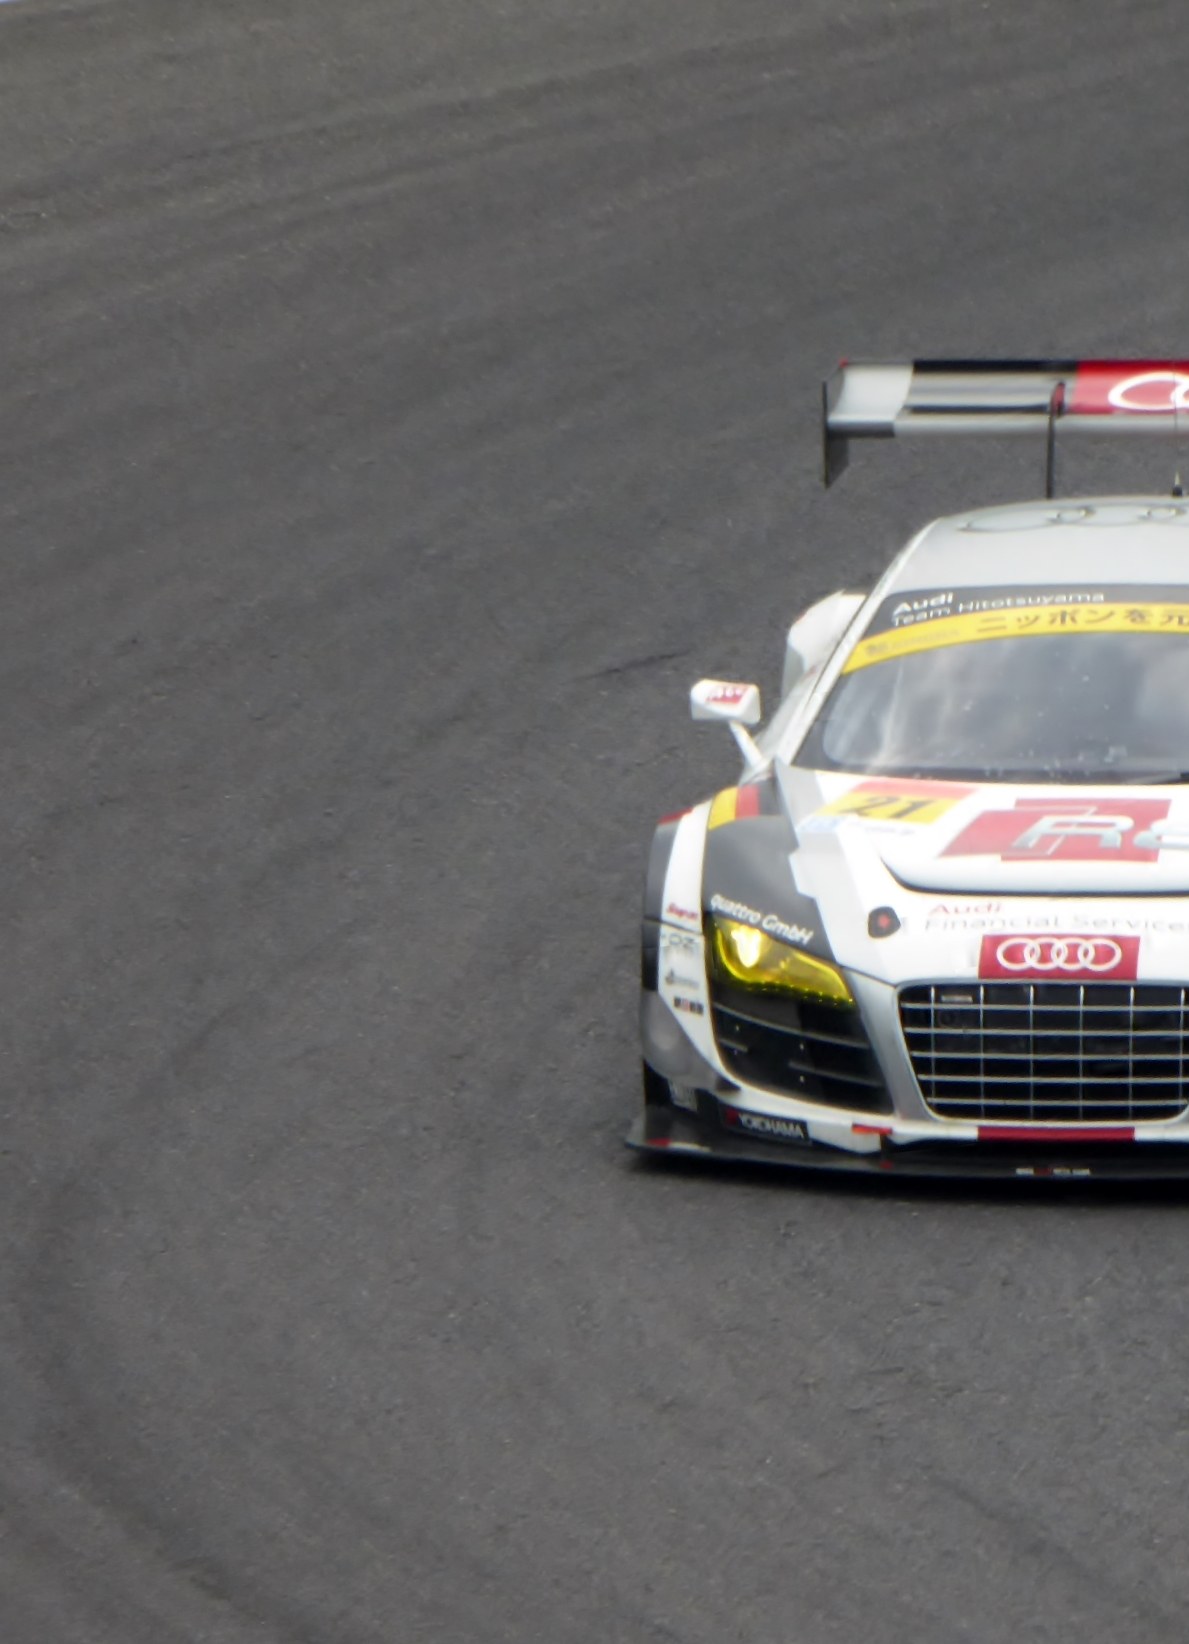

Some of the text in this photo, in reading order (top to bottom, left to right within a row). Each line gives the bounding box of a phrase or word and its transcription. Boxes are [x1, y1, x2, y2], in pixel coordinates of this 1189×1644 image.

[892, 592, 953, 615] Audi
[892, 593, 1105, 627] Team Hitotsuyama
[839, 795, 937, 819] 21
[711, 893, 814, 945] quattro GmbH
[928, 903, 1001, 916] Audi
[924, 914, 1060, 932] Financial
[738, 1112, 805, 1140] YOKOHAMA
